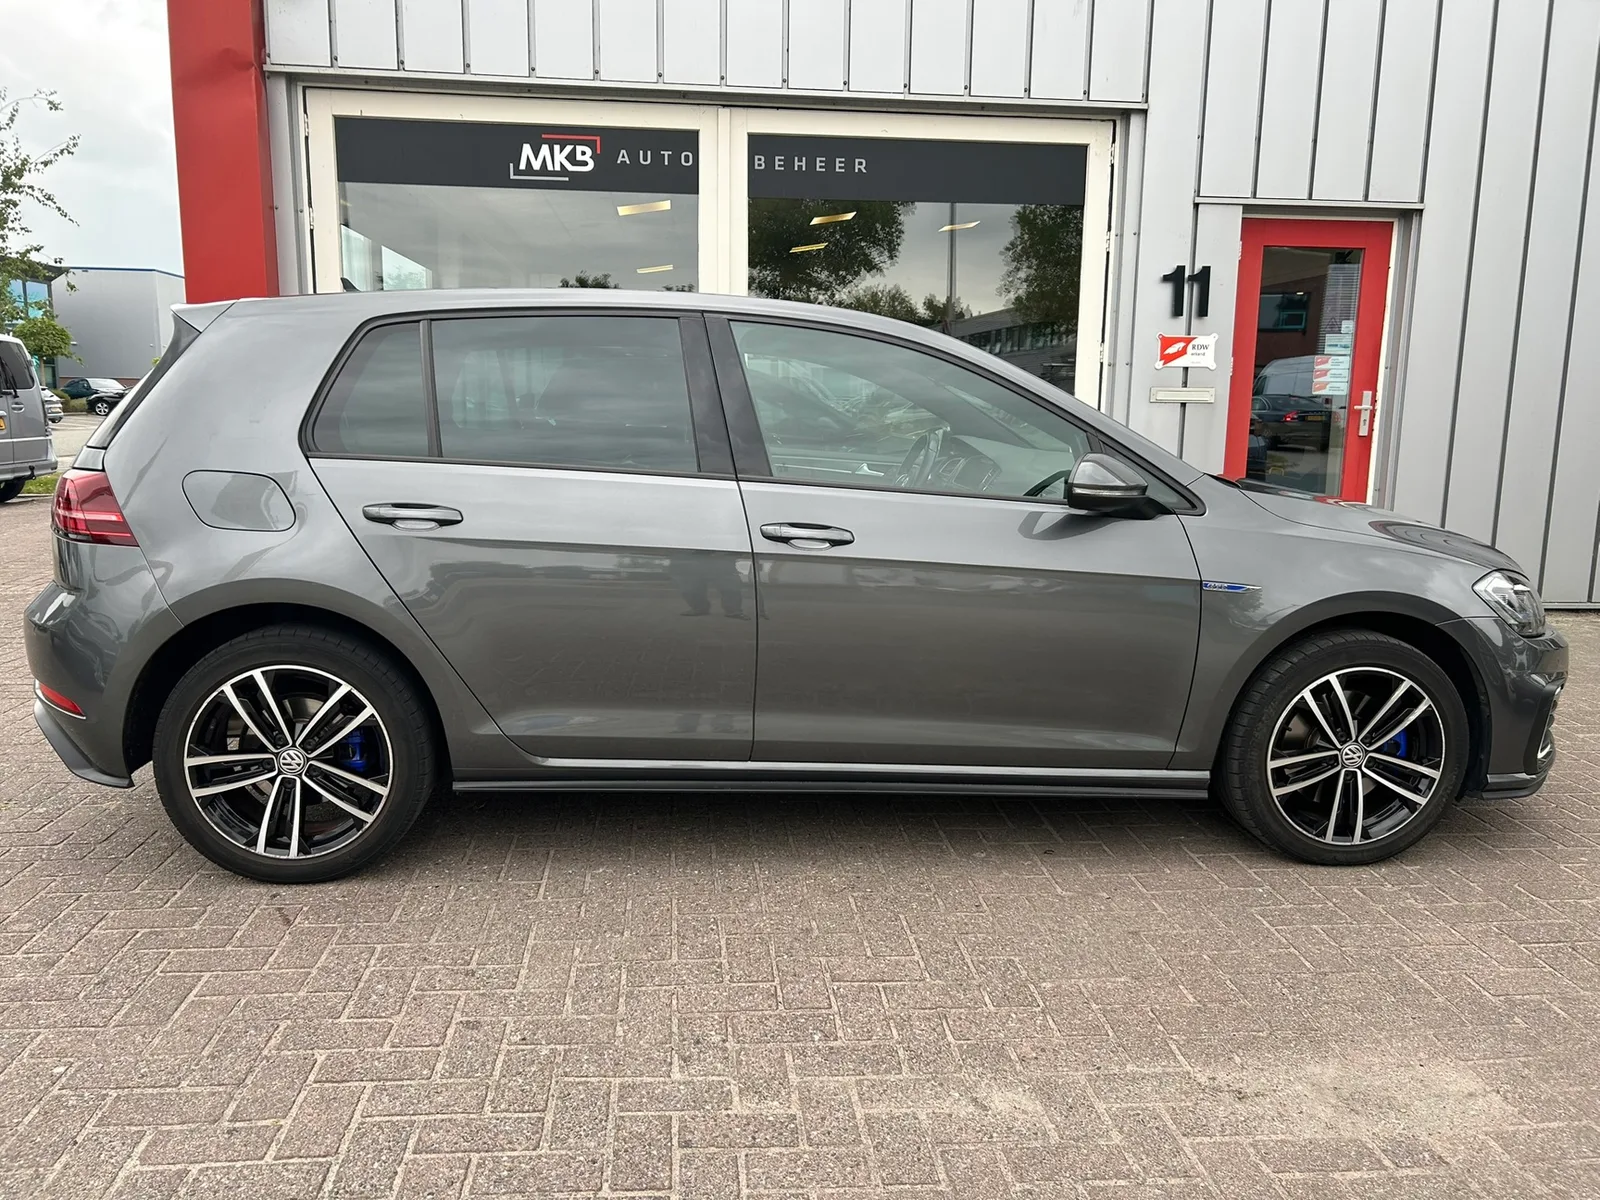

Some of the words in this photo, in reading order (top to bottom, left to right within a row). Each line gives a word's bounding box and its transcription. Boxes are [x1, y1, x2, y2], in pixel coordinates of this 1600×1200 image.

[518, 143, 595, 172] MKB
[616, 149, 693, 166] AUTO
[754, 155, 867, 173] BEHEER
[1162, 265, 1211, 317] 11
